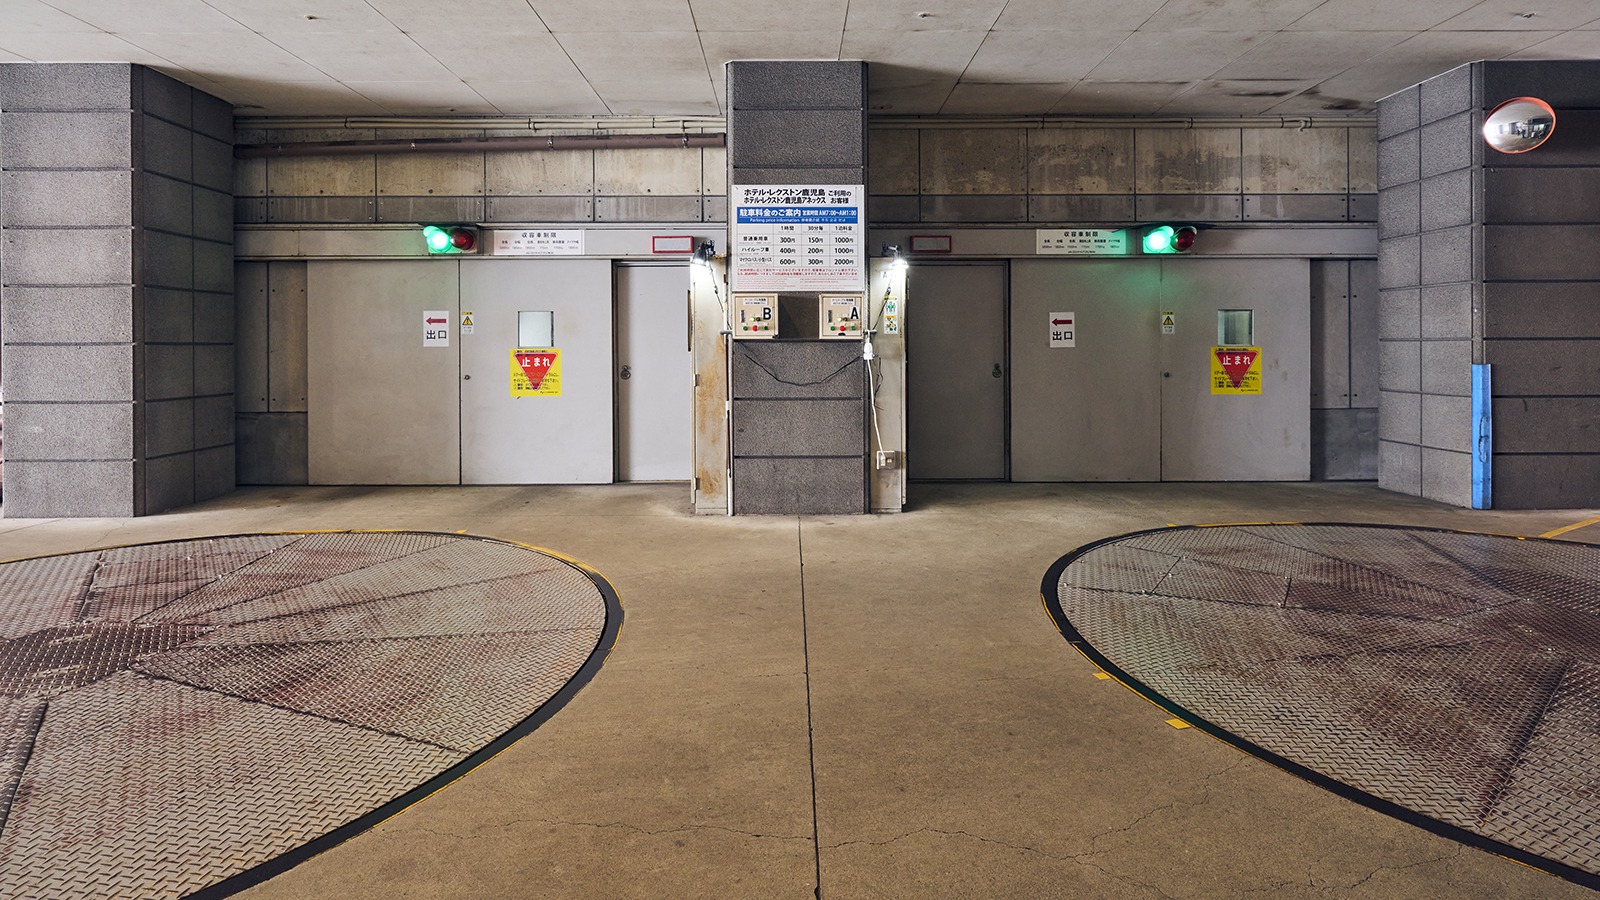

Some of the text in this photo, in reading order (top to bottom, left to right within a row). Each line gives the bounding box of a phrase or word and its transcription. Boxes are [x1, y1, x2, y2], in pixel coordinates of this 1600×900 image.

[739, 208, 801, 217] 駐車料金のご案内
[762, 307, 772, 320] B
[850, 307, 859, 320] A
[426, 330, 447, 340] 出口
[1052, 331, 1073, 341] 出口
[522, 357, 550, 367] 止まれ
[1223, 355, 1250, 365] 止まれ
